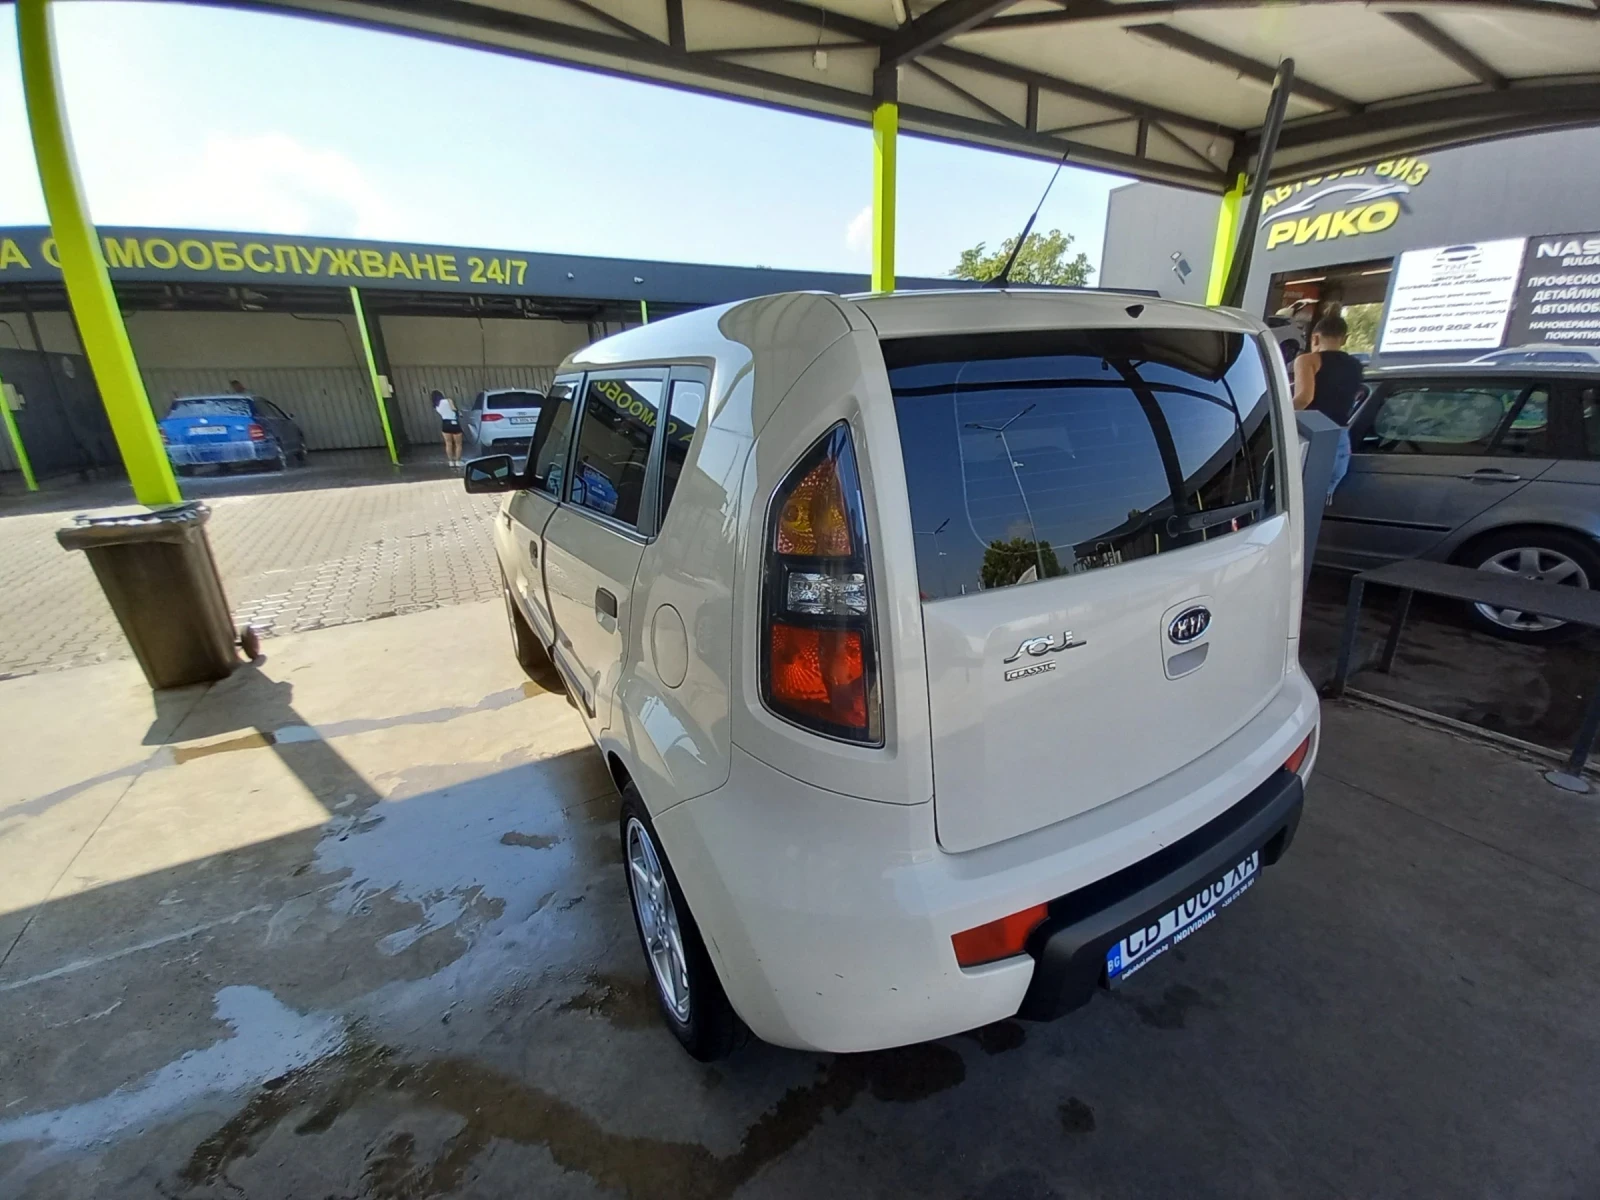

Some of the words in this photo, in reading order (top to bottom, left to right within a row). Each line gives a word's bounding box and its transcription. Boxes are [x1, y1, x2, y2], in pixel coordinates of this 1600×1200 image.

[1266, 200, 1400, 250] РИКО
[41, 236, 460, 283] СМООБСЛУЖВАНЕ
[467, 257, 528, 286] 24/7
[1177, 612, 1206, 639] KIA
[1004, 660, 1056, 682] CLASSIC
[1173, 909, 1217, 945] INDIVIDUAL
[1107, 956, 1121, 973] BG
